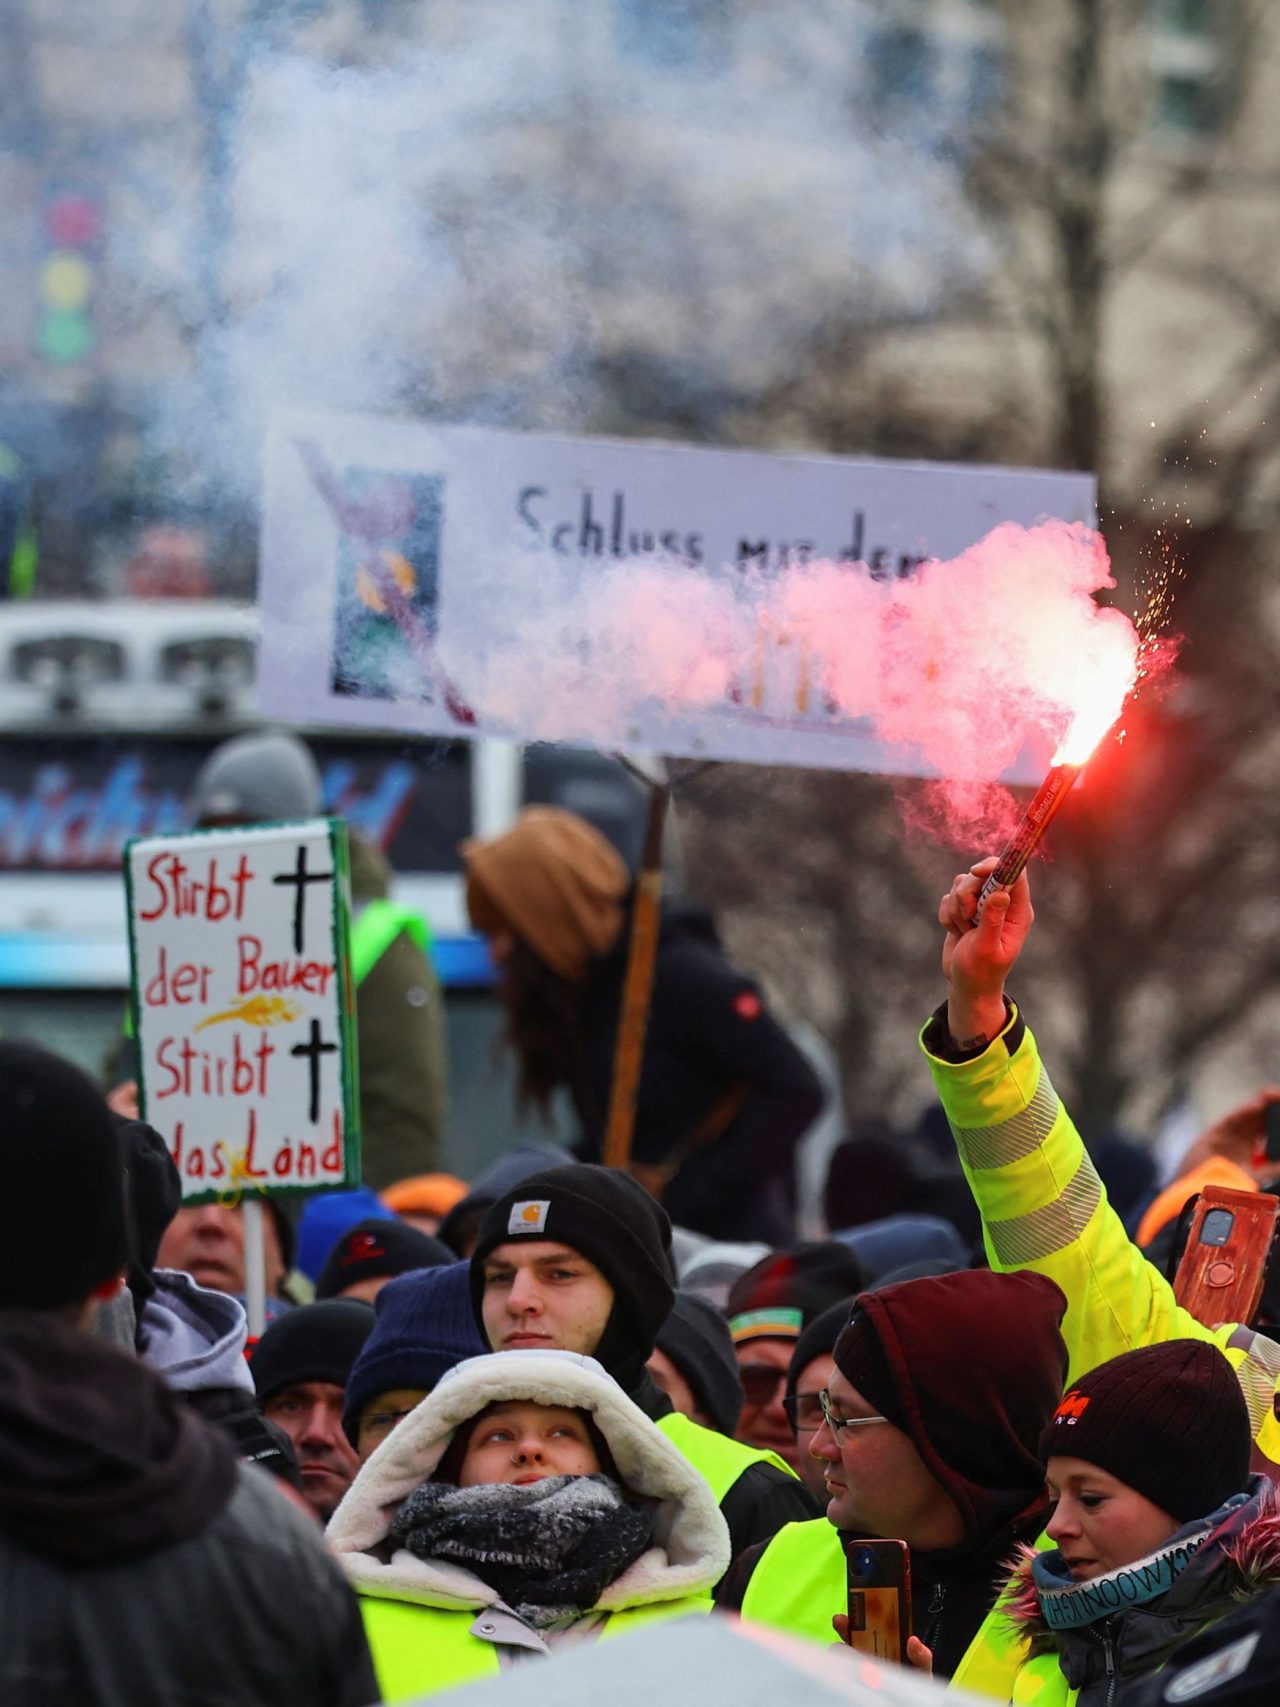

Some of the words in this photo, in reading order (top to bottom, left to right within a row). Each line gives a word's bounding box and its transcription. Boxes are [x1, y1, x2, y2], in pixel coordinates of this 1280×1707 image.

[516, 485, 704, 567] Schluss
[140, 852, 256, 922] Stirbt
[145, 946, 214, 1006] der
[237, 935, 337, 996] Bauer
[156, 1029, 276, 1099] Stirbt
[243, 1107, 343, 1179] Land
